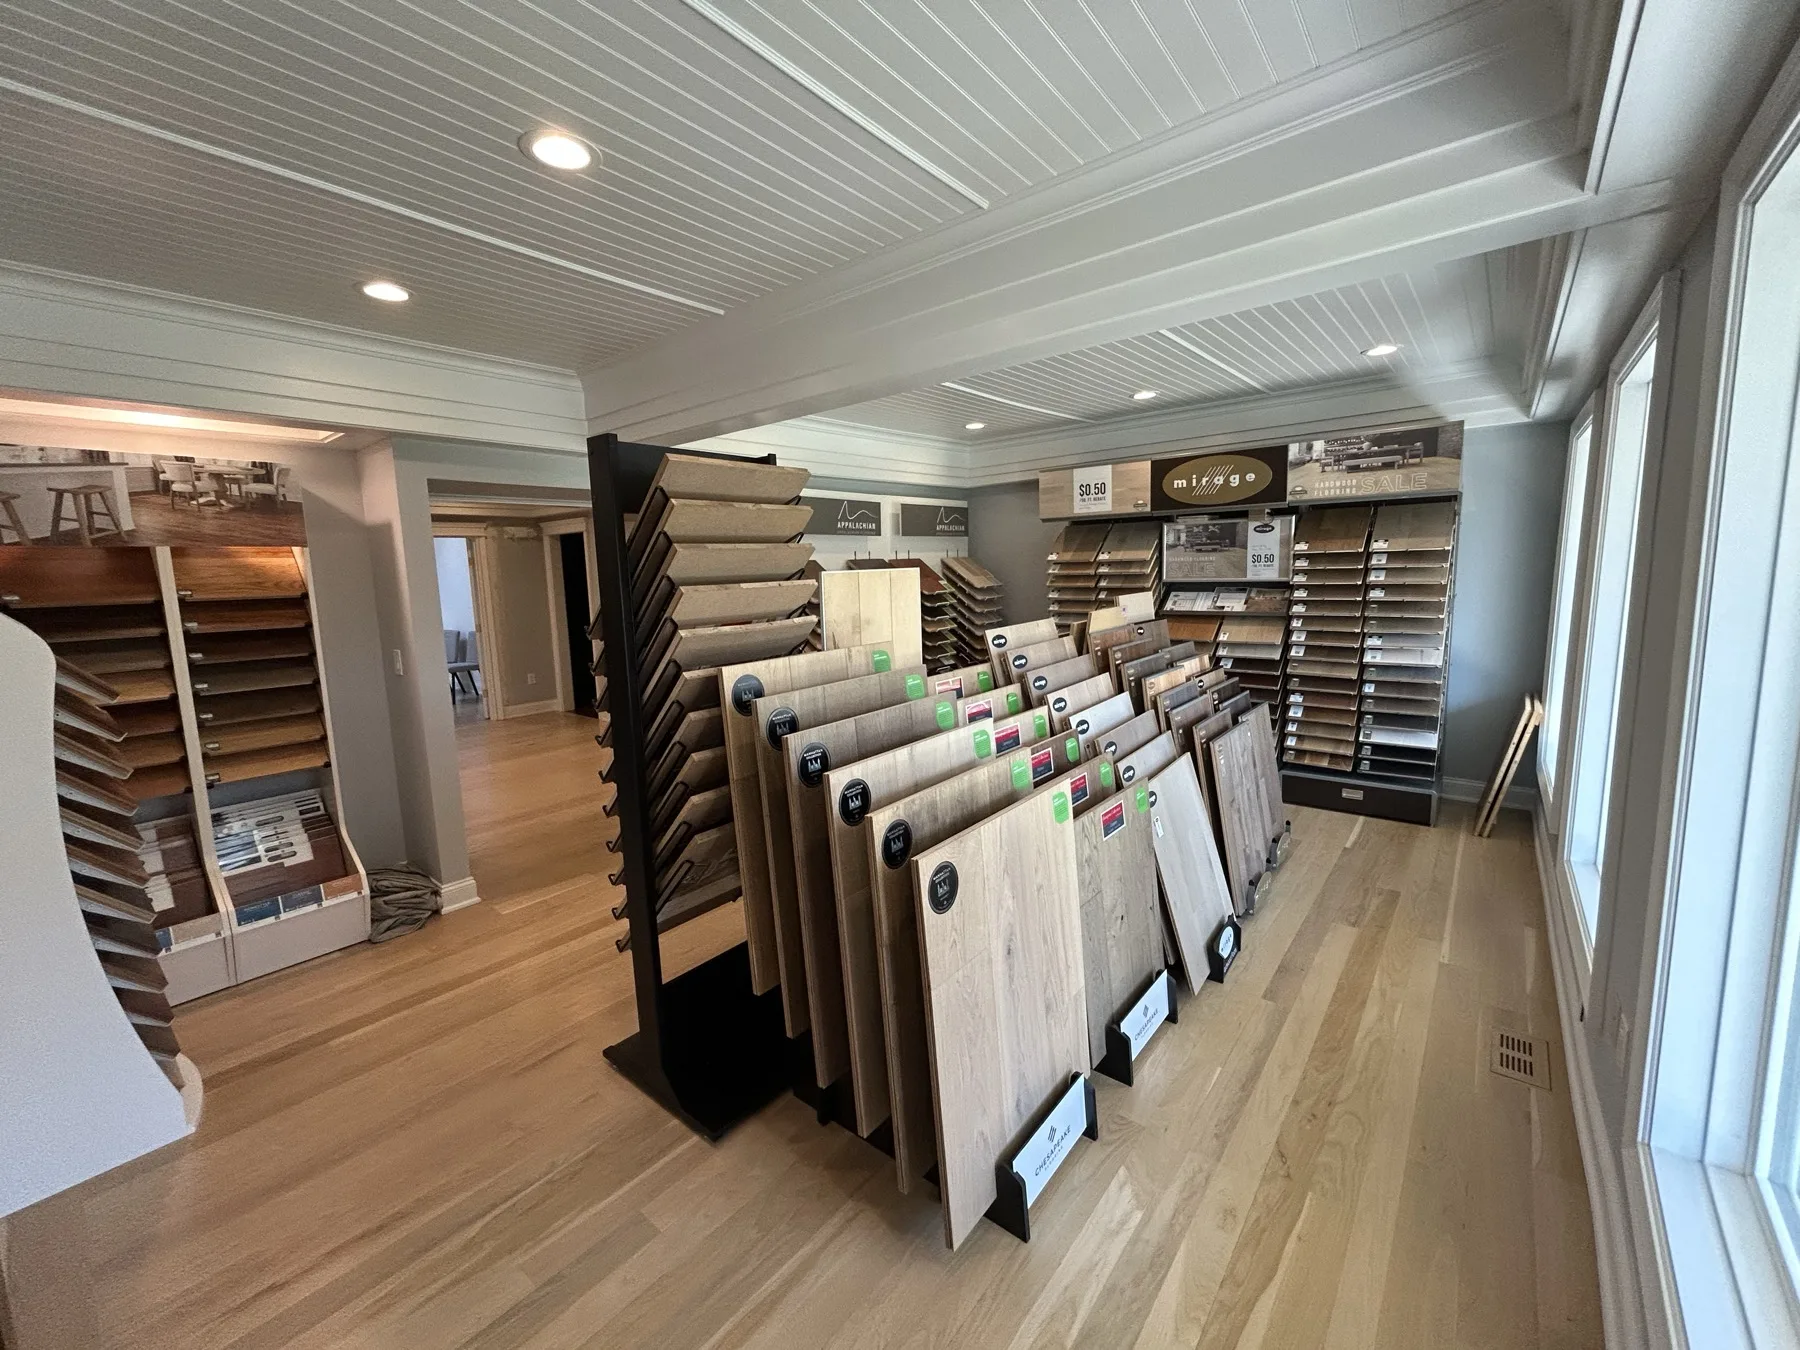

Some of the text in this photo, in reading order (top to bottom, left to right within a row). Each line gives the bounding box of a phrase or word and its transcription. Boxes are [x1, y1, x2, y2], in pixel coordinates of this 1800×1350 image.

[1173, 472, 1256, 488] mirage
[1315, 479, 1356, 488] HARDWOOD
[1361, 472, 1428, 494] SALE
[1079, 482, 1106, 497] $0.50
[837, 521, 876, 530] APPALACHIAN
[1251, 553, 1275, 564] $0.50
[1035, 1124, 1071, 1177] CHESAPEAKE
